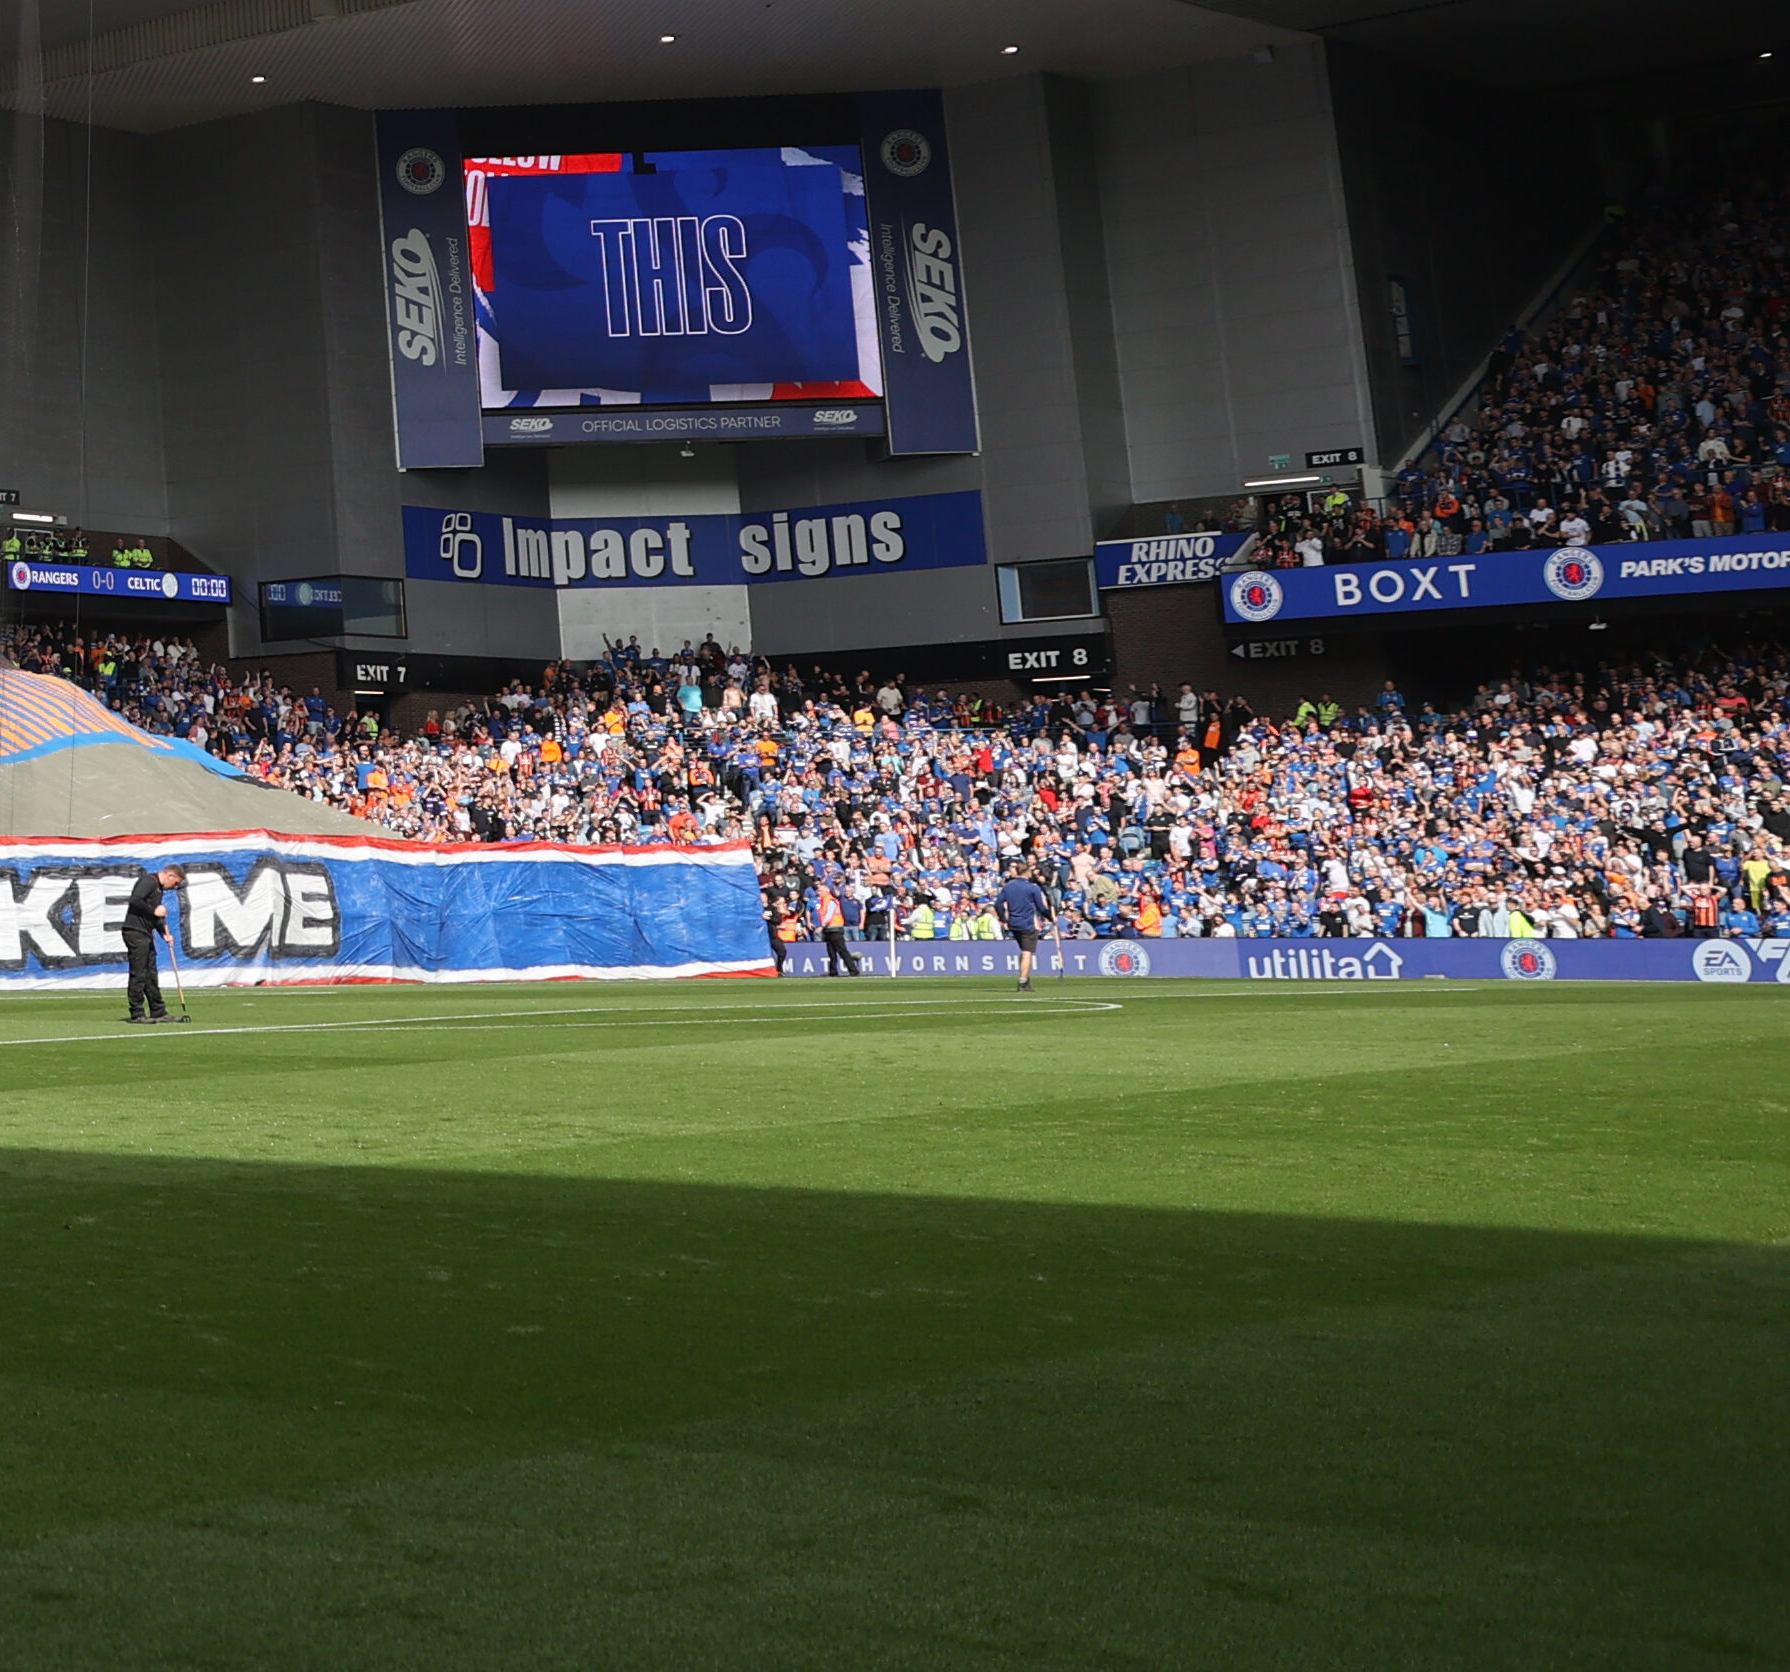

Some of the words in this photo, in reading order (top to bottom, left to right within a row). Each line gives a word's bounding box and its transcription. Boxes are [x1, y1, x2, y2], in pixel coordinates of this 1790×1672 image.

[446, 237, 463, 295] Delivered
[880, 223, 898, 293] Intelligence
[591, 214, 753, 337] THIS
[391, 227, 436, 367] SEKO
[912, 222, 961, 363] SEKO
[449, 296, 467, 366] Intelligence
[886, 294, 905, 354] Delivered
[510, 417, 553, 432] SEKO
[582, 418, 643, 433] OFFICIAL
[646, 417, 717, 431] LOGISTICS
[721, 416, 781, 430] PARTNER
[813, 409, 858, 425] SEKO
[1311, 452, 1342, 465] EXIT
[1348, 451, 1358, 461] 8
[10, 493, 16, 502] 7
[502, 517, 694, 585] Impact
[739, 511, 904, 576] signs
[1131, 537, 1215, 563] RHINO
[1620, 556, 1705, 578] PARK'S
[32, 572, 79, 586] RANGERS
[92, 570, 114, 590] 0-0
[128, 577, 161, 591] CELTIC
[192, 577, 227, 597] 00:00
[1335, 564, 1476, 606] BOXT
[1008, 650, 1059, 670] EXIT
[1072, 648, 1088, 665] 8
[1249, 640, 1300, 659] EXIT
[1309, 638, 1324, 655] 8
[356, 663, 391, 684] EXIT
[397, 666, 407, 686] 7
[183, 862, 336, 953] ME
[1248, 948, 1363, 979] utilita
[1704, 950, 1740, 966] EA
[1703, 967, 1743, 976] SPORTS
